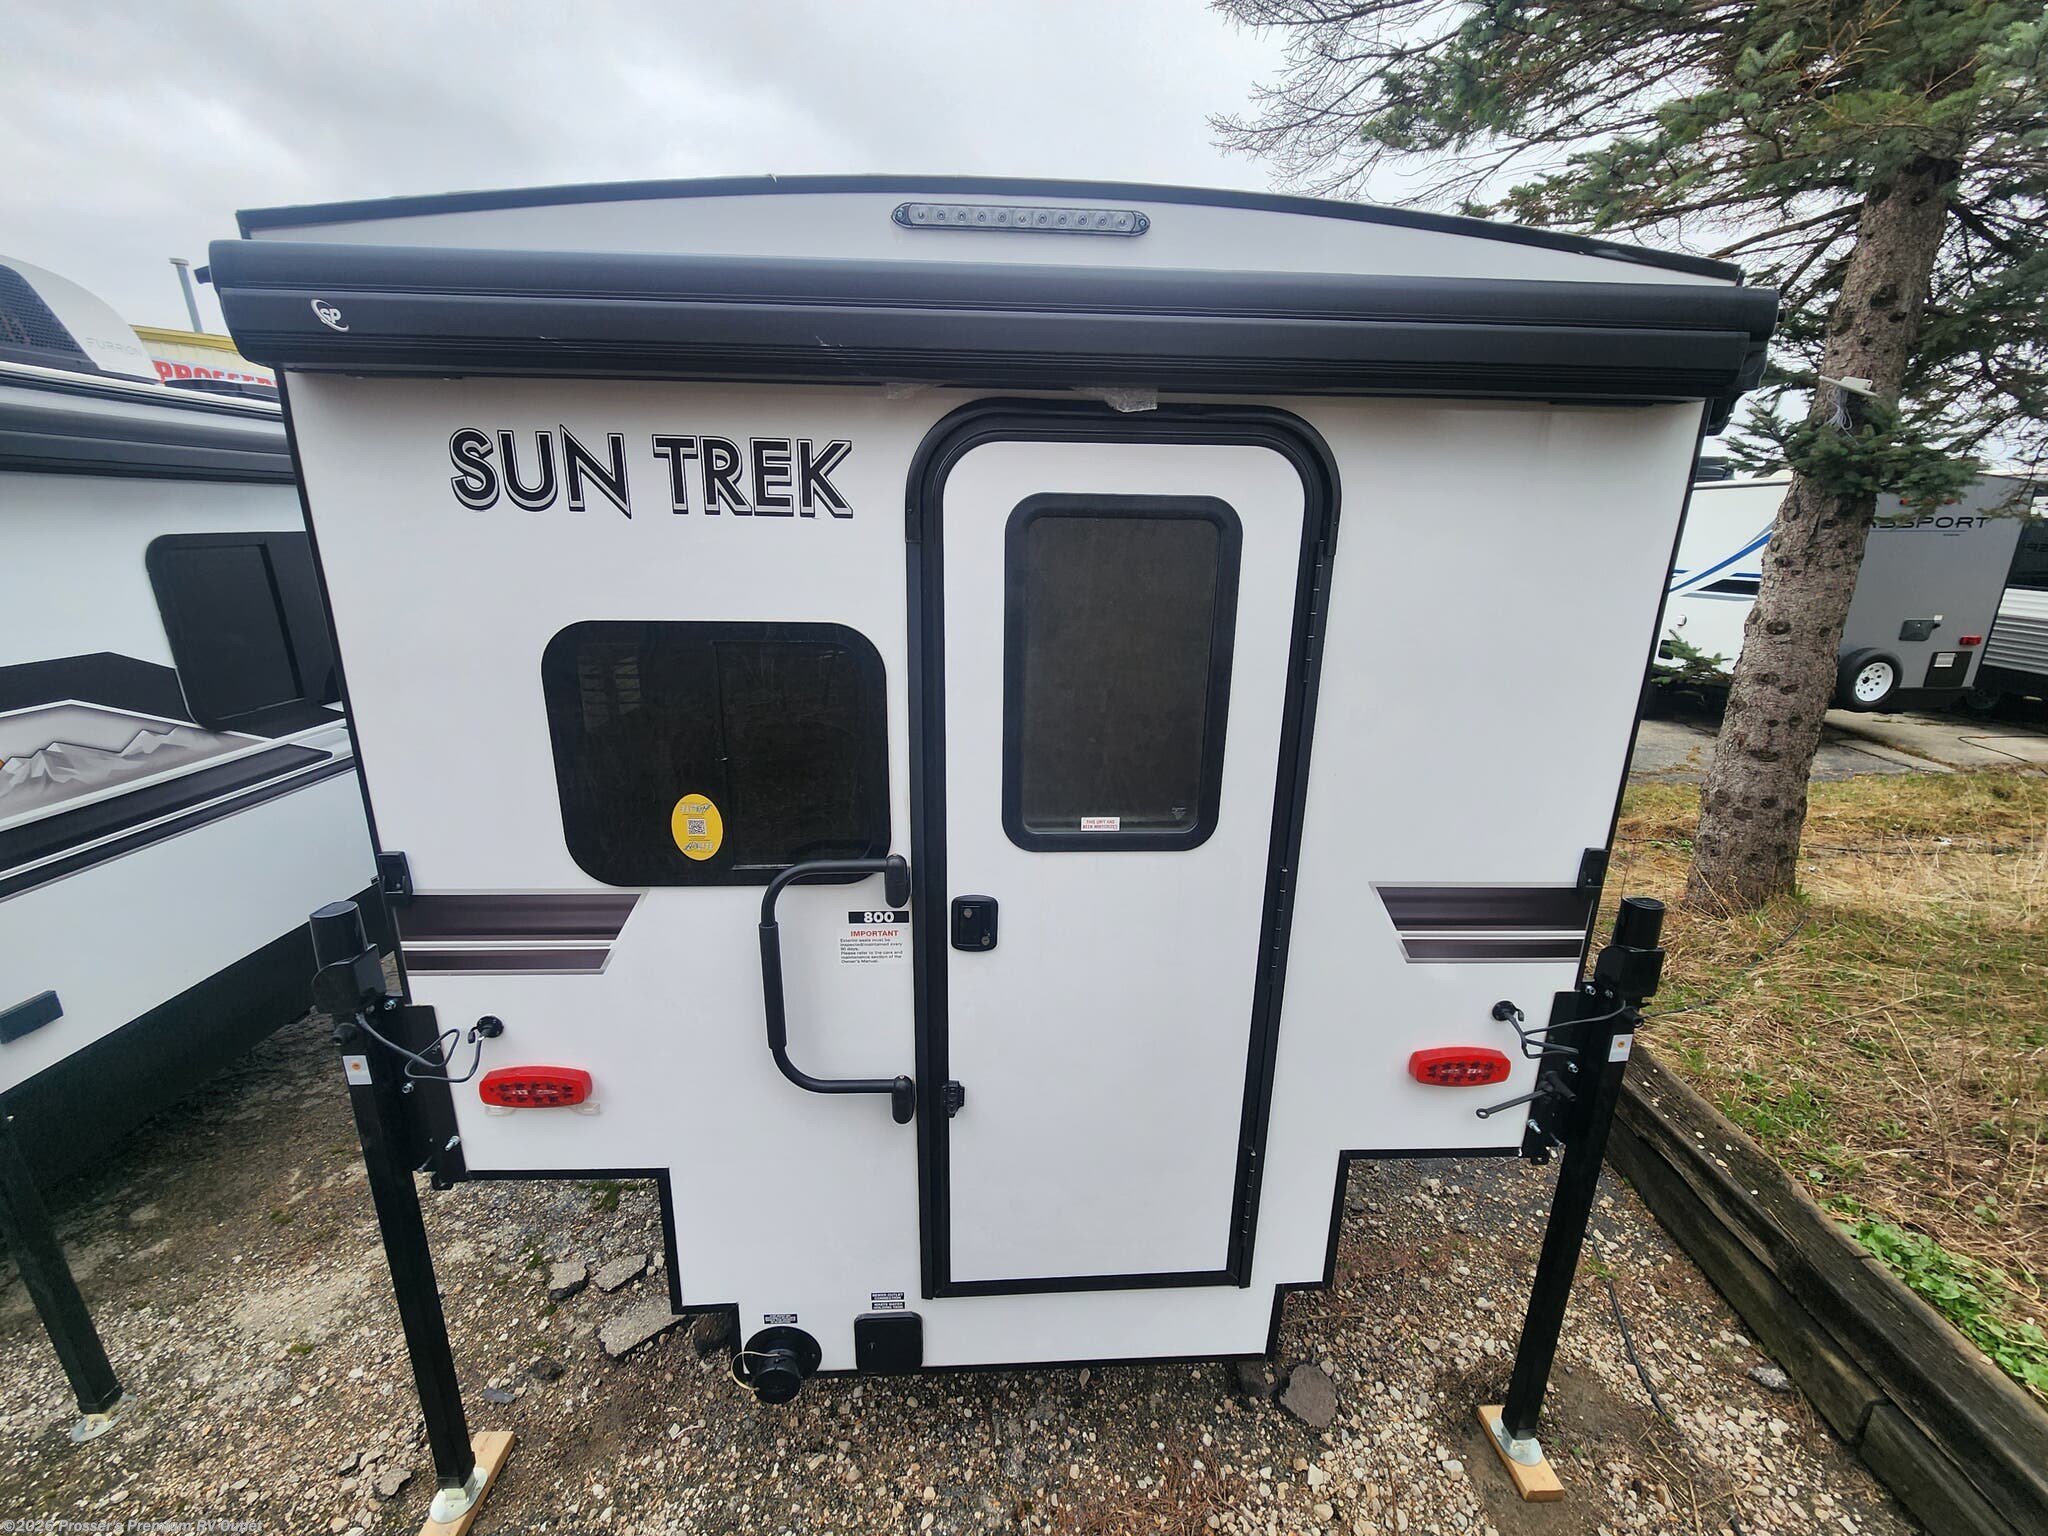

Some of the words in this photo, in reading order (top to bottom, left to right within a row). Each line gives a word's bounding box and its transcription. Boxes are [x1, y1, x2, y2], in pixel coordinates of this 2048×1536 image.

[449, 424, 632, 519] SUN
[651, 432, 853, 519] TREK
[864, 911, 894, 923] 800
